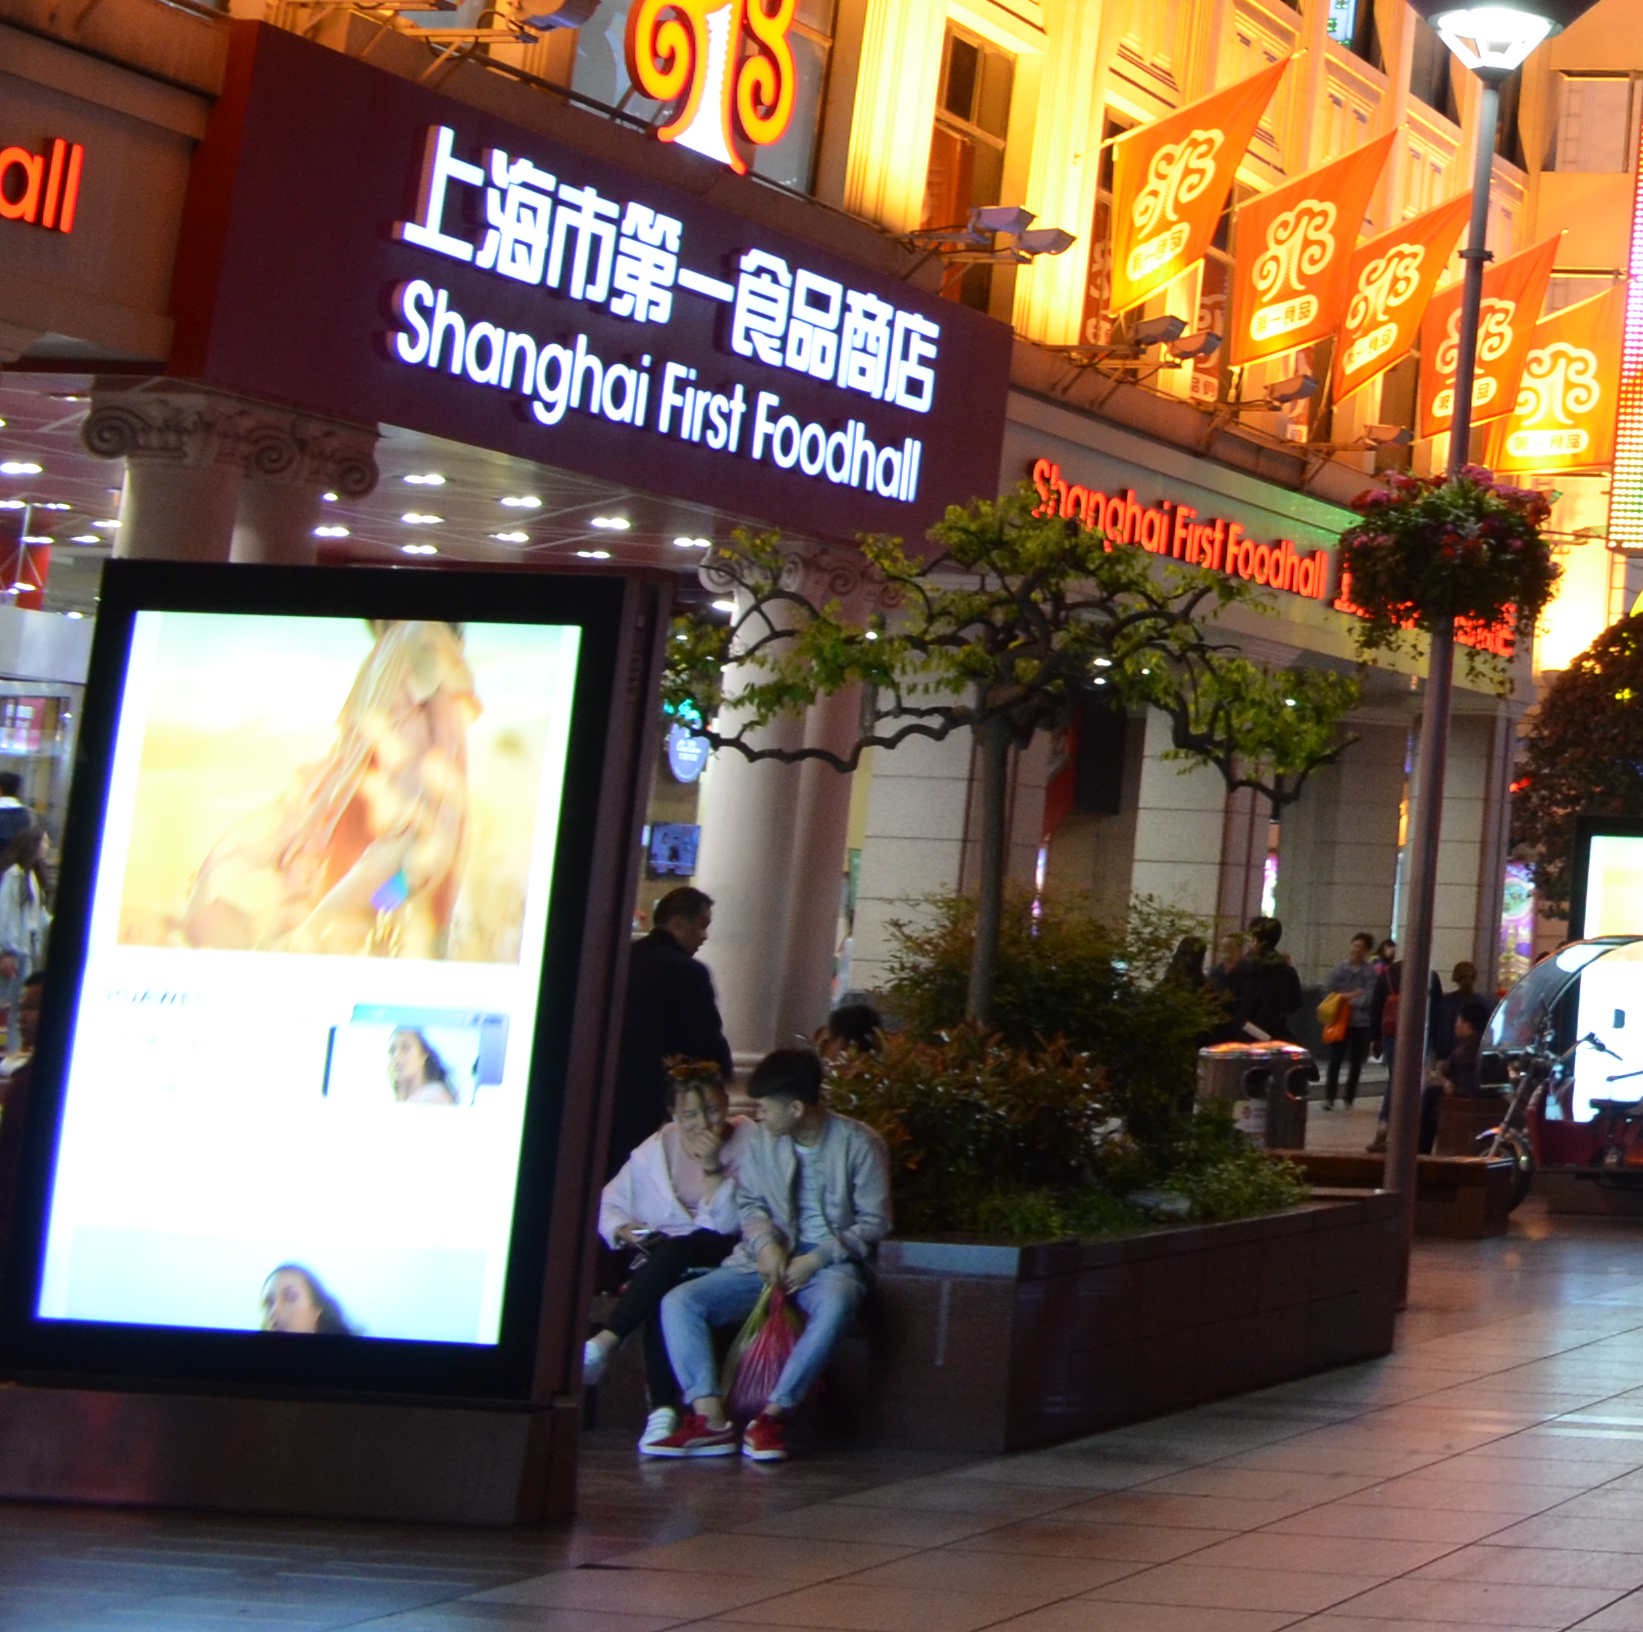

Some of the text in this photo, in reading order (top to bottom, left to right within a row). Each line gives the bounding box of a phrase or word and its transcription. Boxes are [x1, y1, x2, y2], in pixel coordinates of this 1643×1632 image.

[400, 124, 941, 414] 上海市第一食品商店
[396, 279, 923, 504] Shanghai First Foodhall
[1173, 504, 1224, 571] First
[1226, 522, 1328, 600] Foodhall
